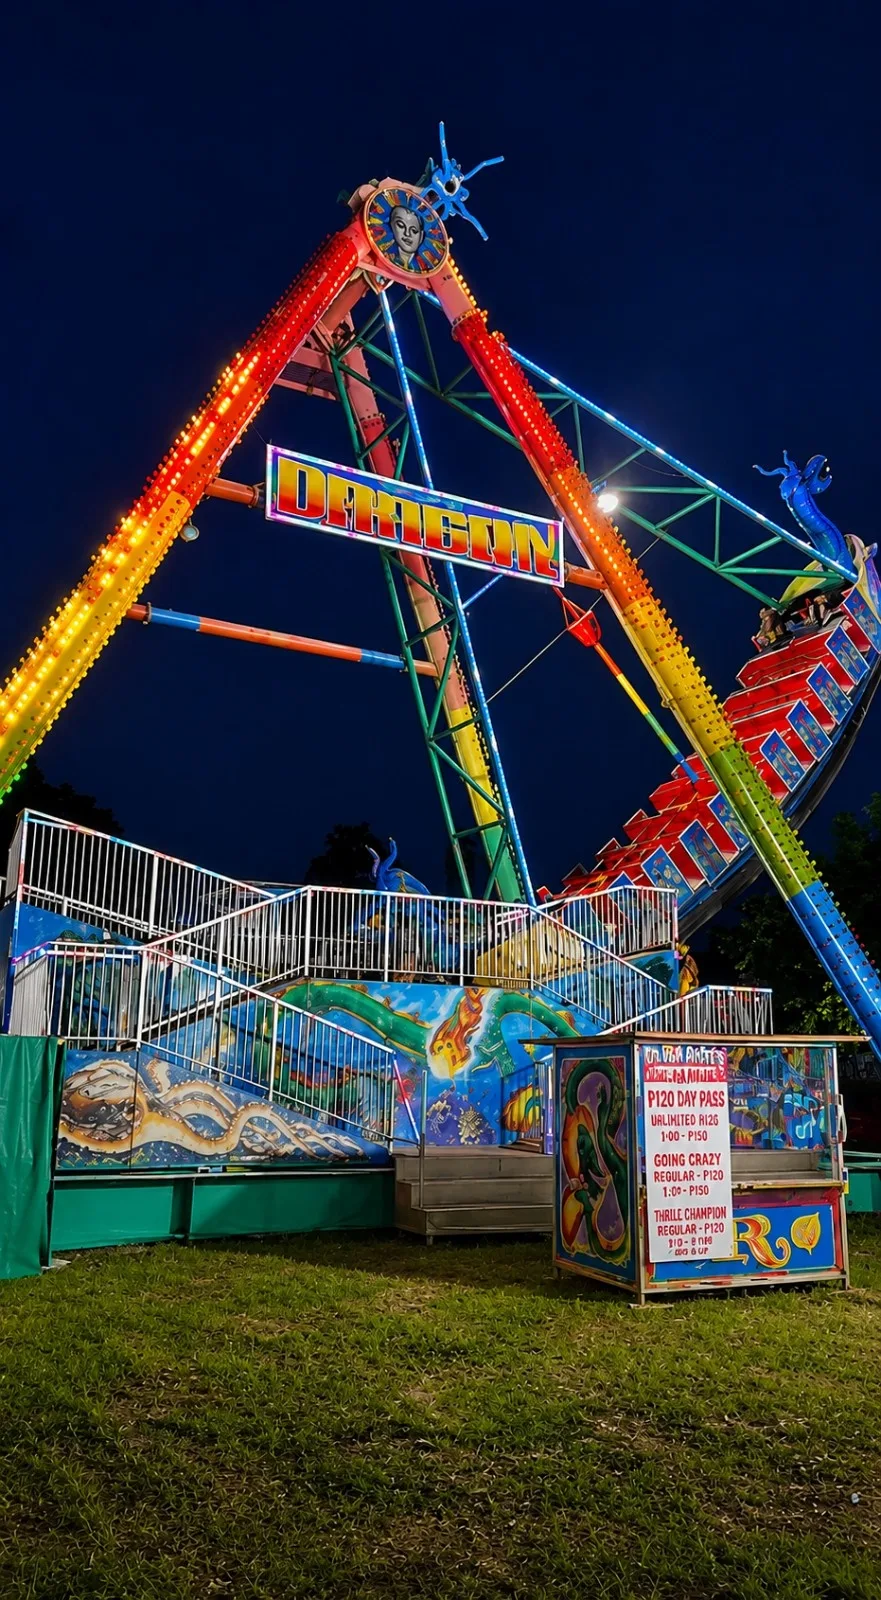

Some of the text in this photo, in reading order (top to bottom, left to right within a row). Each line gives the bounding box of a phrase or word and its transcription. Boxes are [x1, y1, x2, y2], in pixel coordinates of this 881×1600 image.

[648, 1090, 725, 1108] P120 DAY PASS
[654, 1153, 685, 1167] GOING
[654, 1171, 695, 1182] REGULAR
[704, 1170, 724, 1180] P120
[685, 1206, 727, 1220] CHAMPION
[657, 1224, 697, 1236] REGULAR
[705, 1223, 724, 1234] P120
